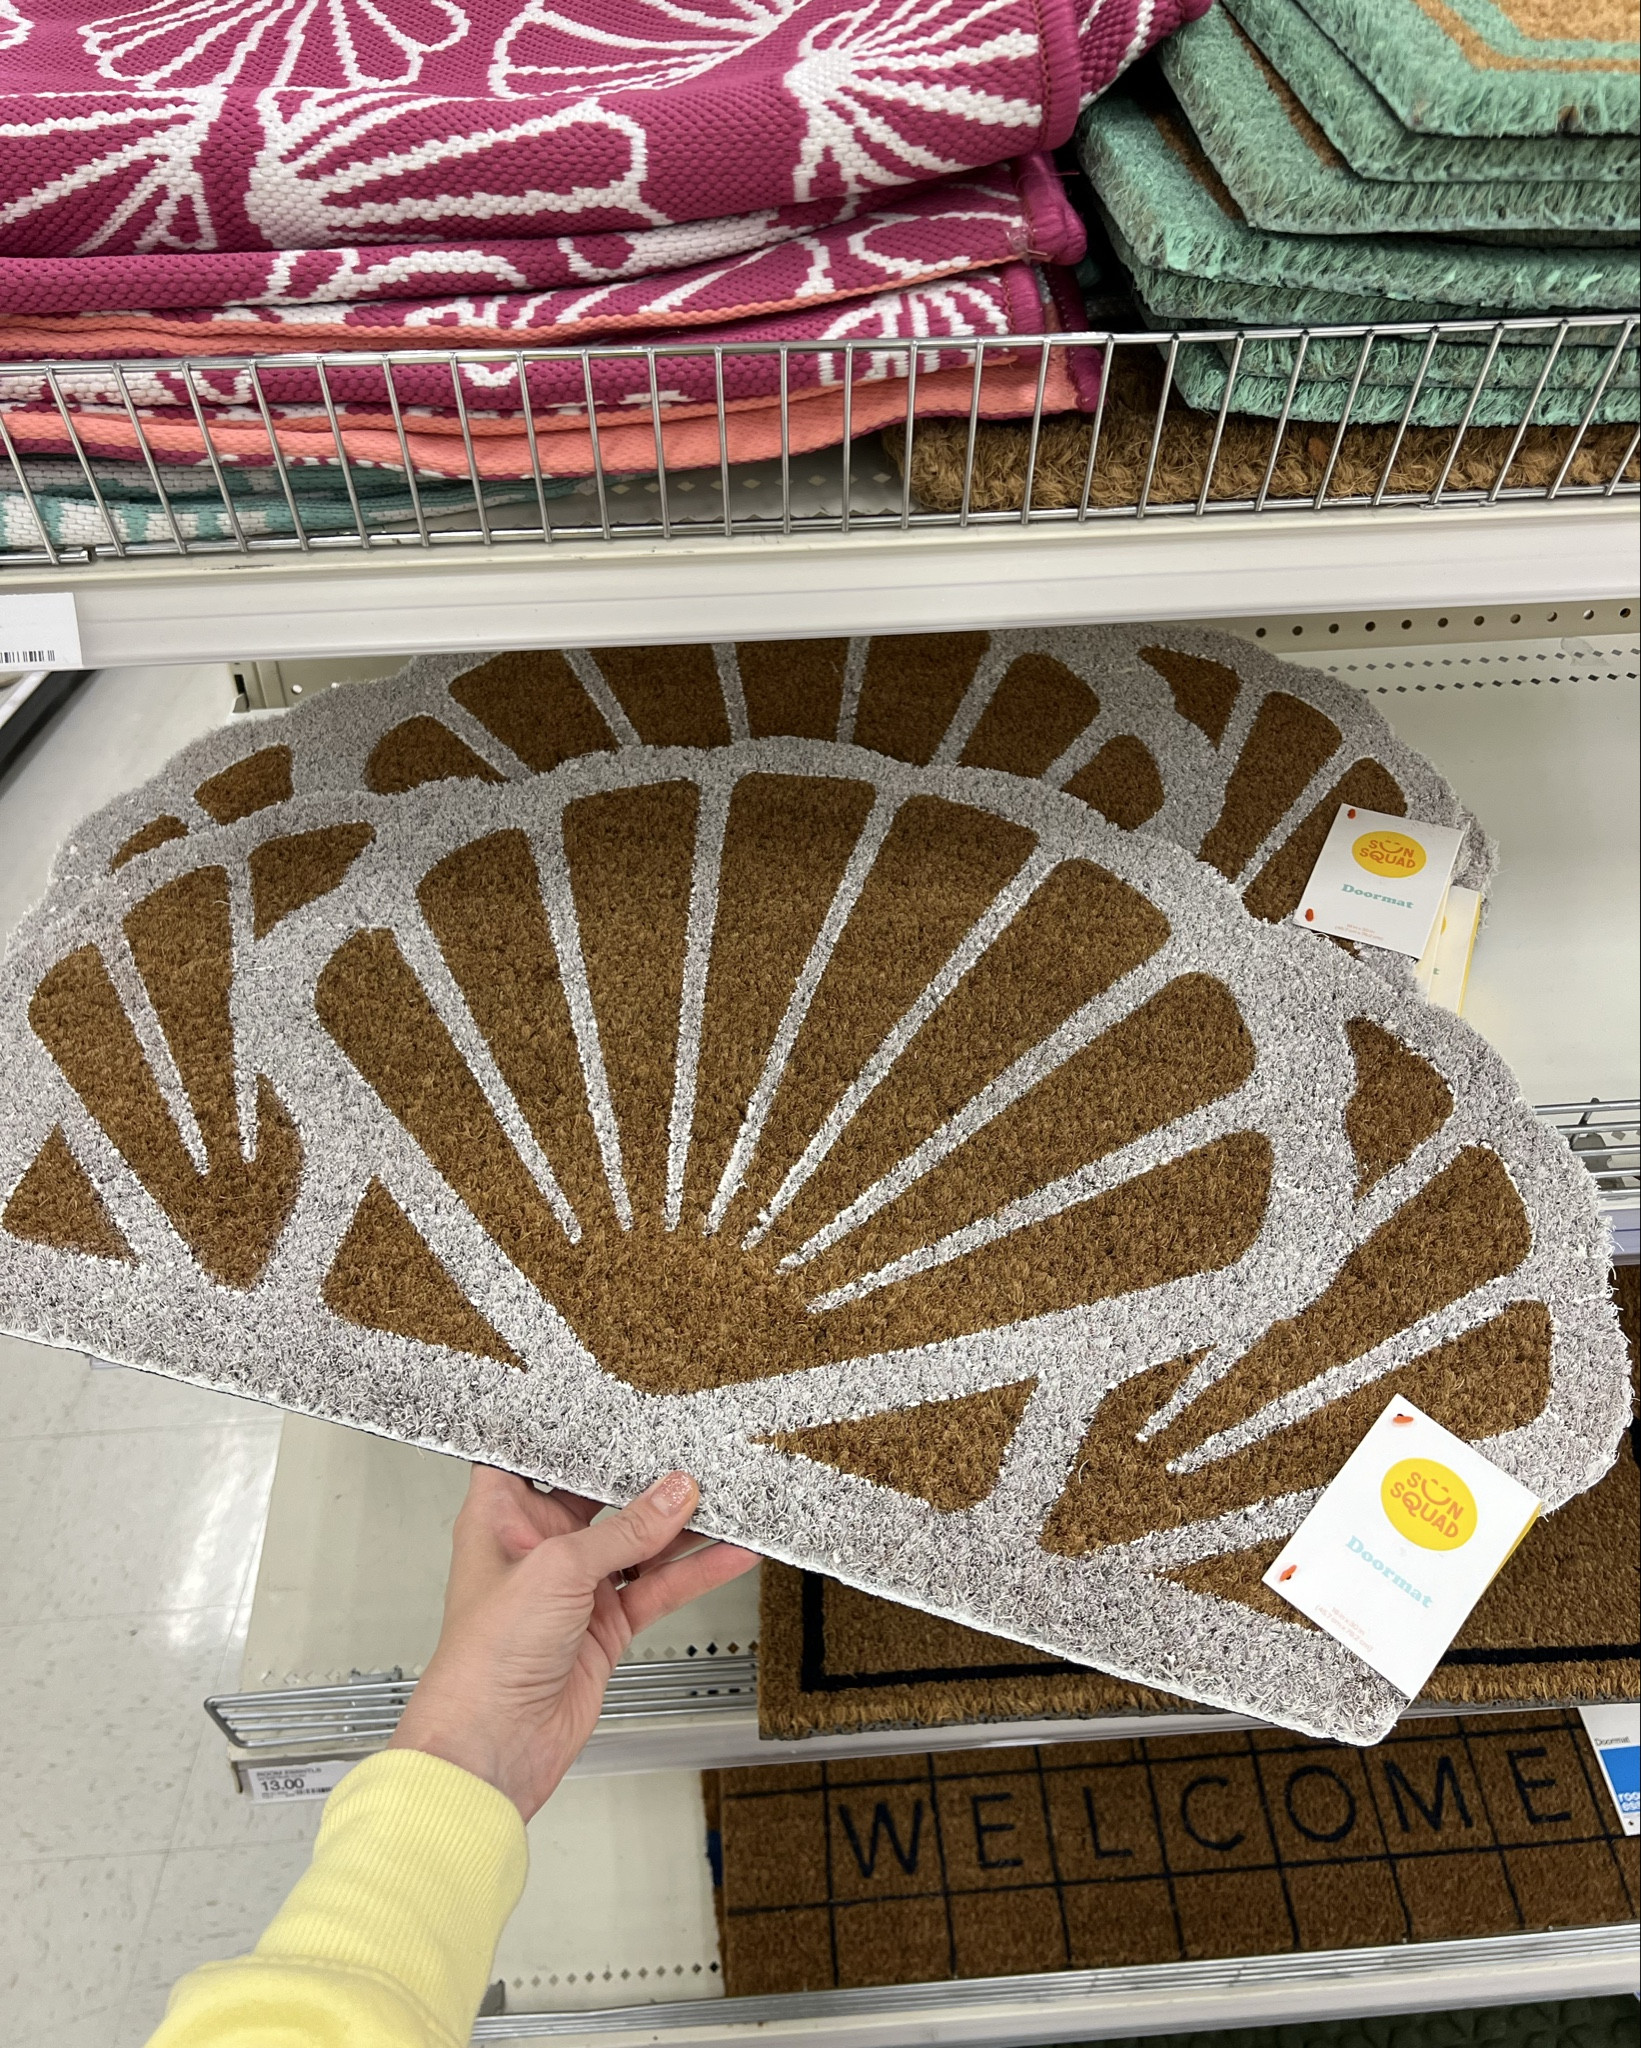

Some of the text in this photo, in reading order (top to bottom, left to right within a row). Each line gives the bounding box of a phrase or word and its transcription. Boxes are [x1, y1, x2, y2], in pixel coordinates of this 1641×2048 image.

[1359, 847, 1416, 869] SQUAD
[1368, 839, 1415, 858] SUN
[1341, 883, 1414, 909] Doormat
[1406, 1471, 1464, 1520] SUN
[1390, 1482, 1459, 1538] SQUAD
[1345, 1535, 1433, 1608] Doormat
[1594, 1737, 1631, 1746] Doormat
[261, 1778, 304, 1792] 13.00
[838, 1746, 1571, 1879] WELCOME
